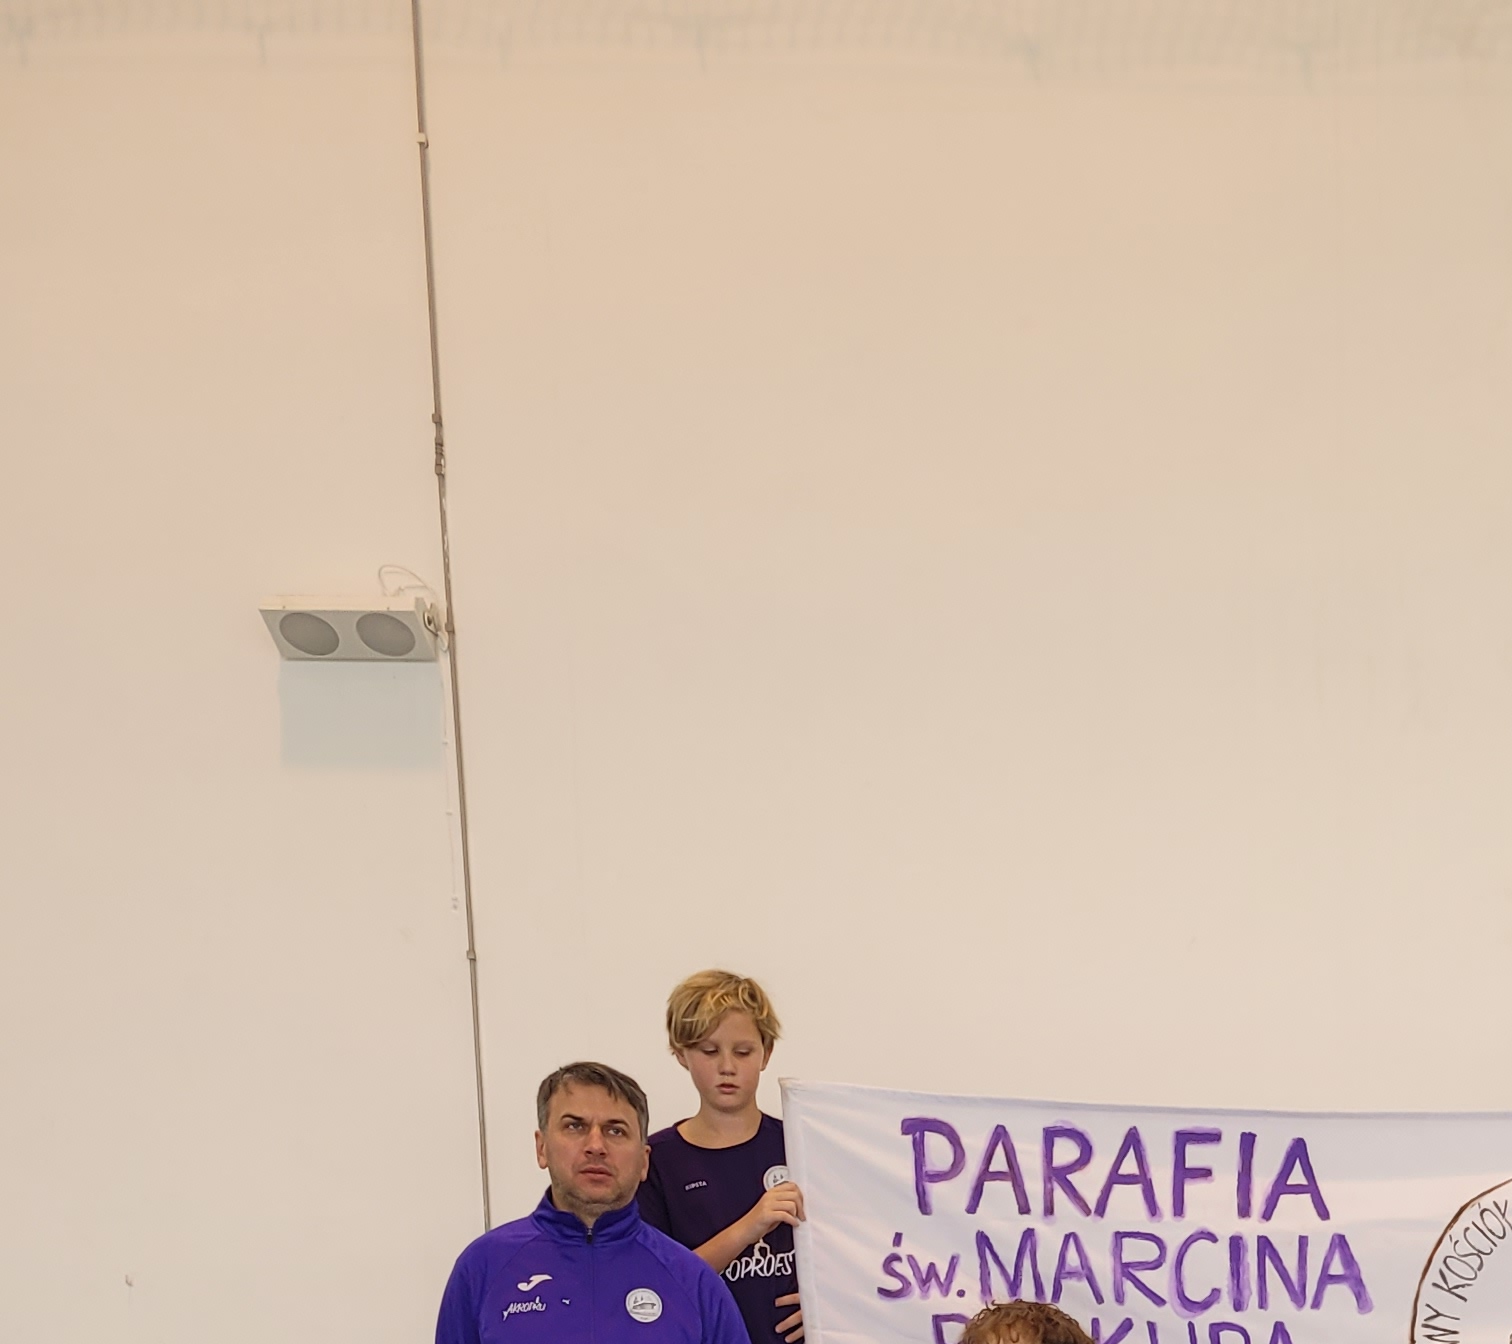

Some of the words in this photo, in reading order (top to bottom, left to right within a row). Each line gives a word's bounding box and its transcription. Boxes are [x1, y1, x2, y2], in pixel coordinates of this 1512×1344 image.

[901, 1116, 1330, 1222] PARAFIA
[876, 1231, 966, 1300] św.
[974, 1226, 1371, 1315] MARCINA
